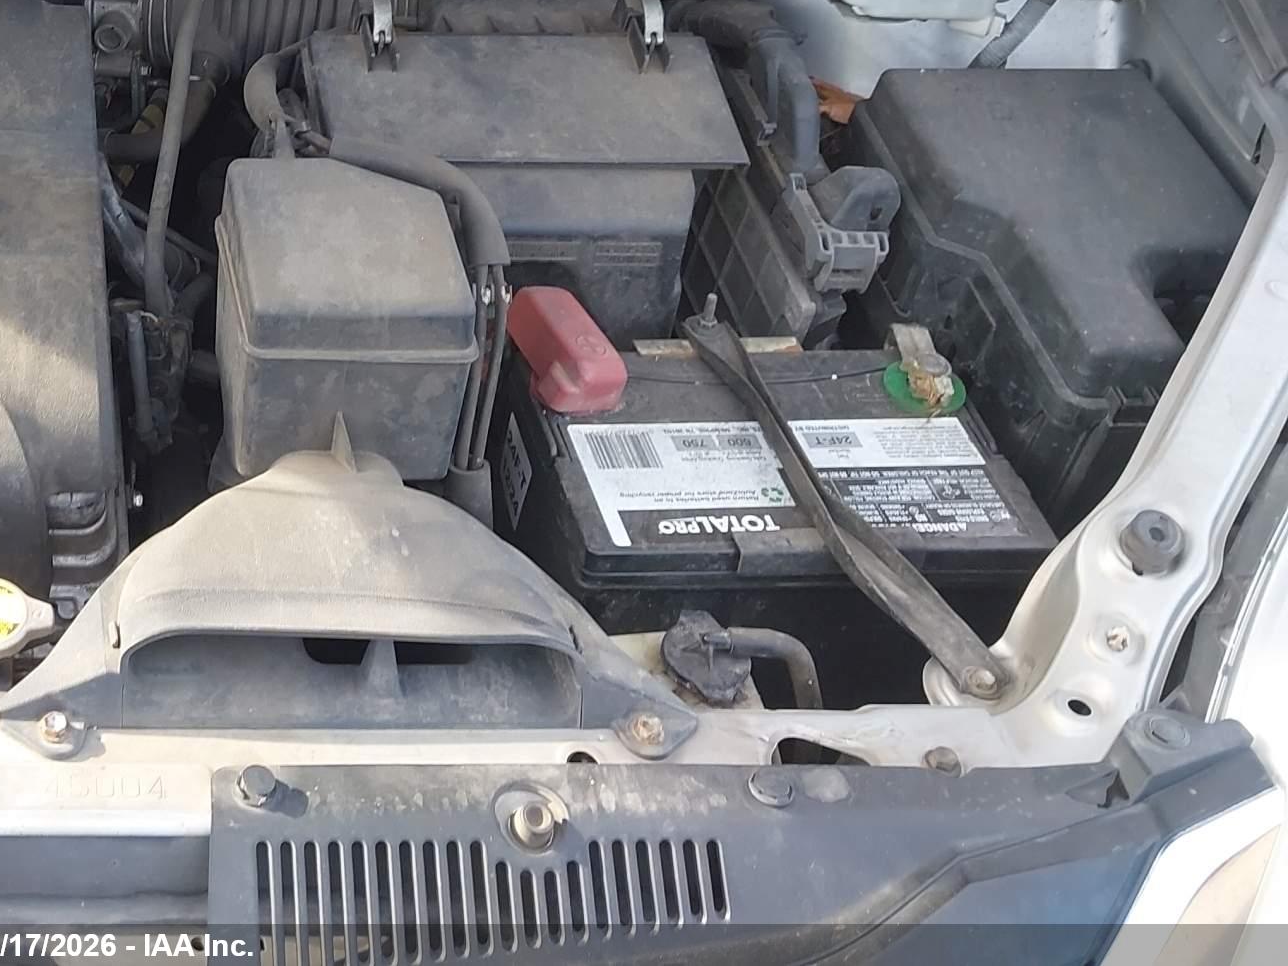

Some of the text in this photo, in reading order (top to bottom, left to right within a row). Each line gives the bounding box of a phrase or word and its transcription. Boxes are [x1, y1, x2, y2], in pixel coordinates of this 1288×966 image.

[682, 438, 706, 448] 750
[815, 435, 852, 445] 24F-T
[658, 514, 781, 535] TOTALPRO
